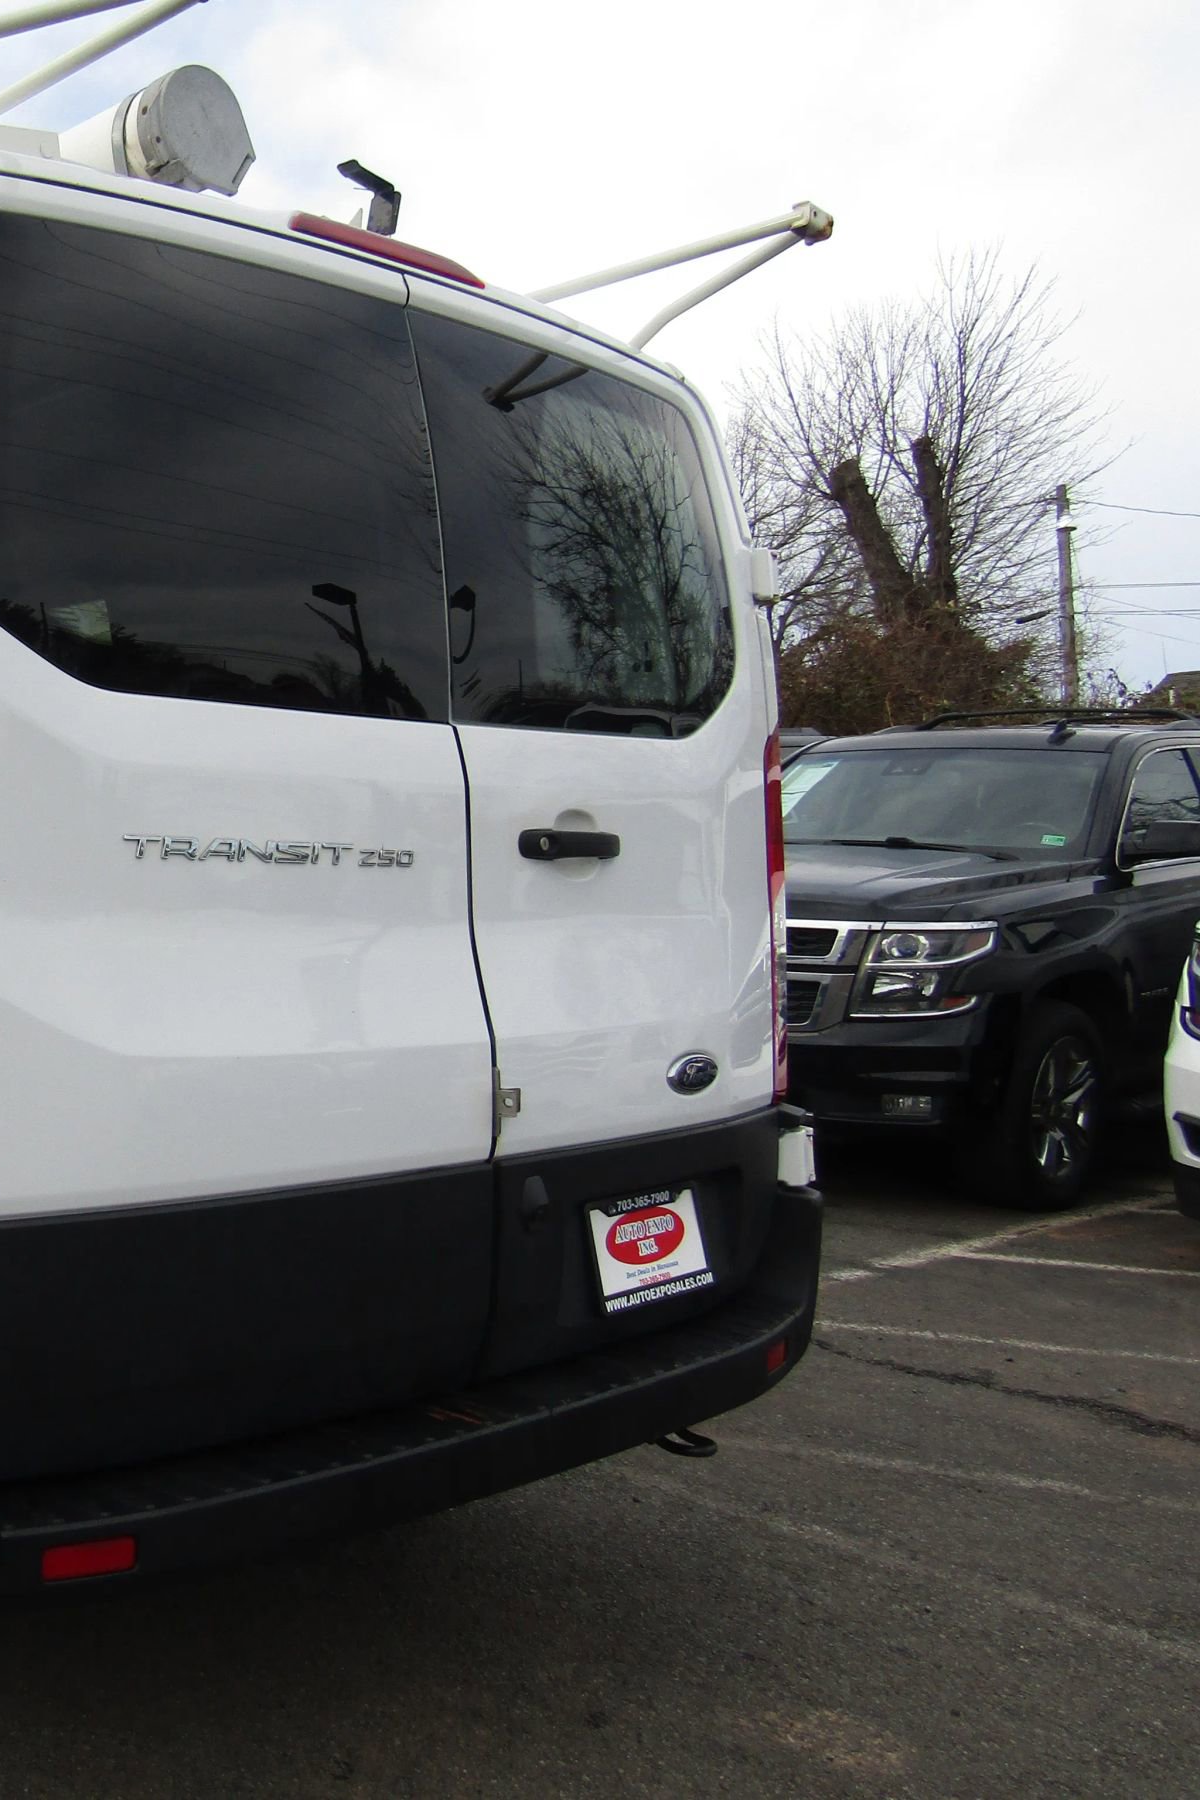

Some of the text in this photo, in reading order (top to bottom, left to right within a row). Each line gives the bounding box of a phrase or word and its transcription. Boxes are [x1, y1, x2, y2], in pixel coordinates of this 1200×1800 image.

[121, 833, 416, 867] TRANSIT 250
[616, 1190, 670, 1212] 703-365-7900
[615, 1214, 675, 1244] AUTO EXPO
[637, 1237, 659, 1256] INC.
[605, 1272, 714, 1313] WWW.AUTOEXPOSALES.COM
